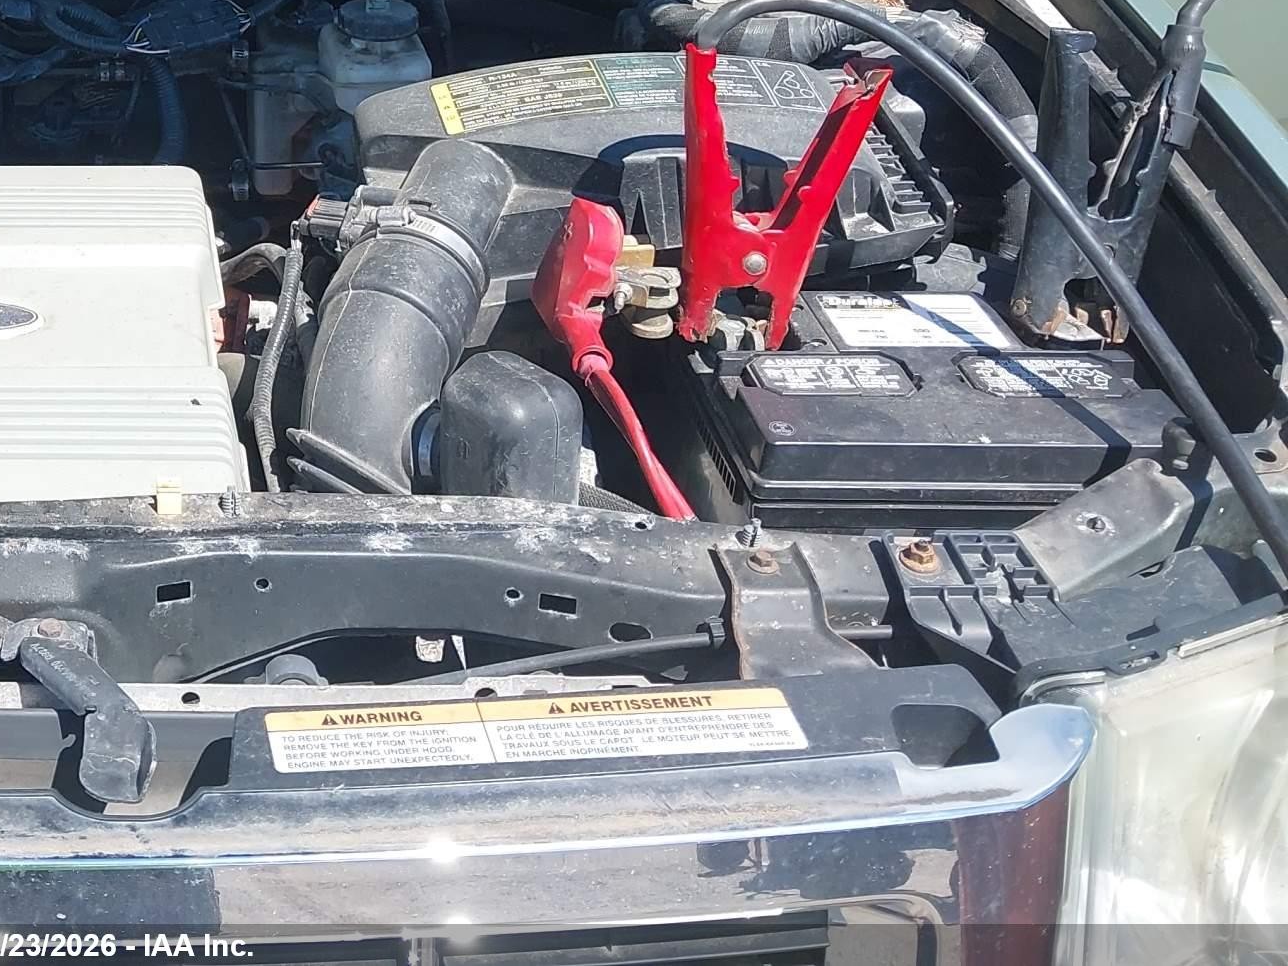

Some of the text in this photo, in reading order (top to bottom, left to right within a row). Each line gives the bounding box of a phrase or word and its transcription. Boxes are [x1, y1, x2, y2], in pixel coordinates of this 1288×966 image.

[570, 695, 712, 713] AVERTISSEMENT
[338, 710, 422, 724] WARNING
[283, 743, 328, 751] REMOVE
[432, 736, 476, 744] IGNITION
[298, 733, 340, 742] REDUCE
[286, 751, 328, 759] BEFORE
[330, 749, 380, 757] WORKING
